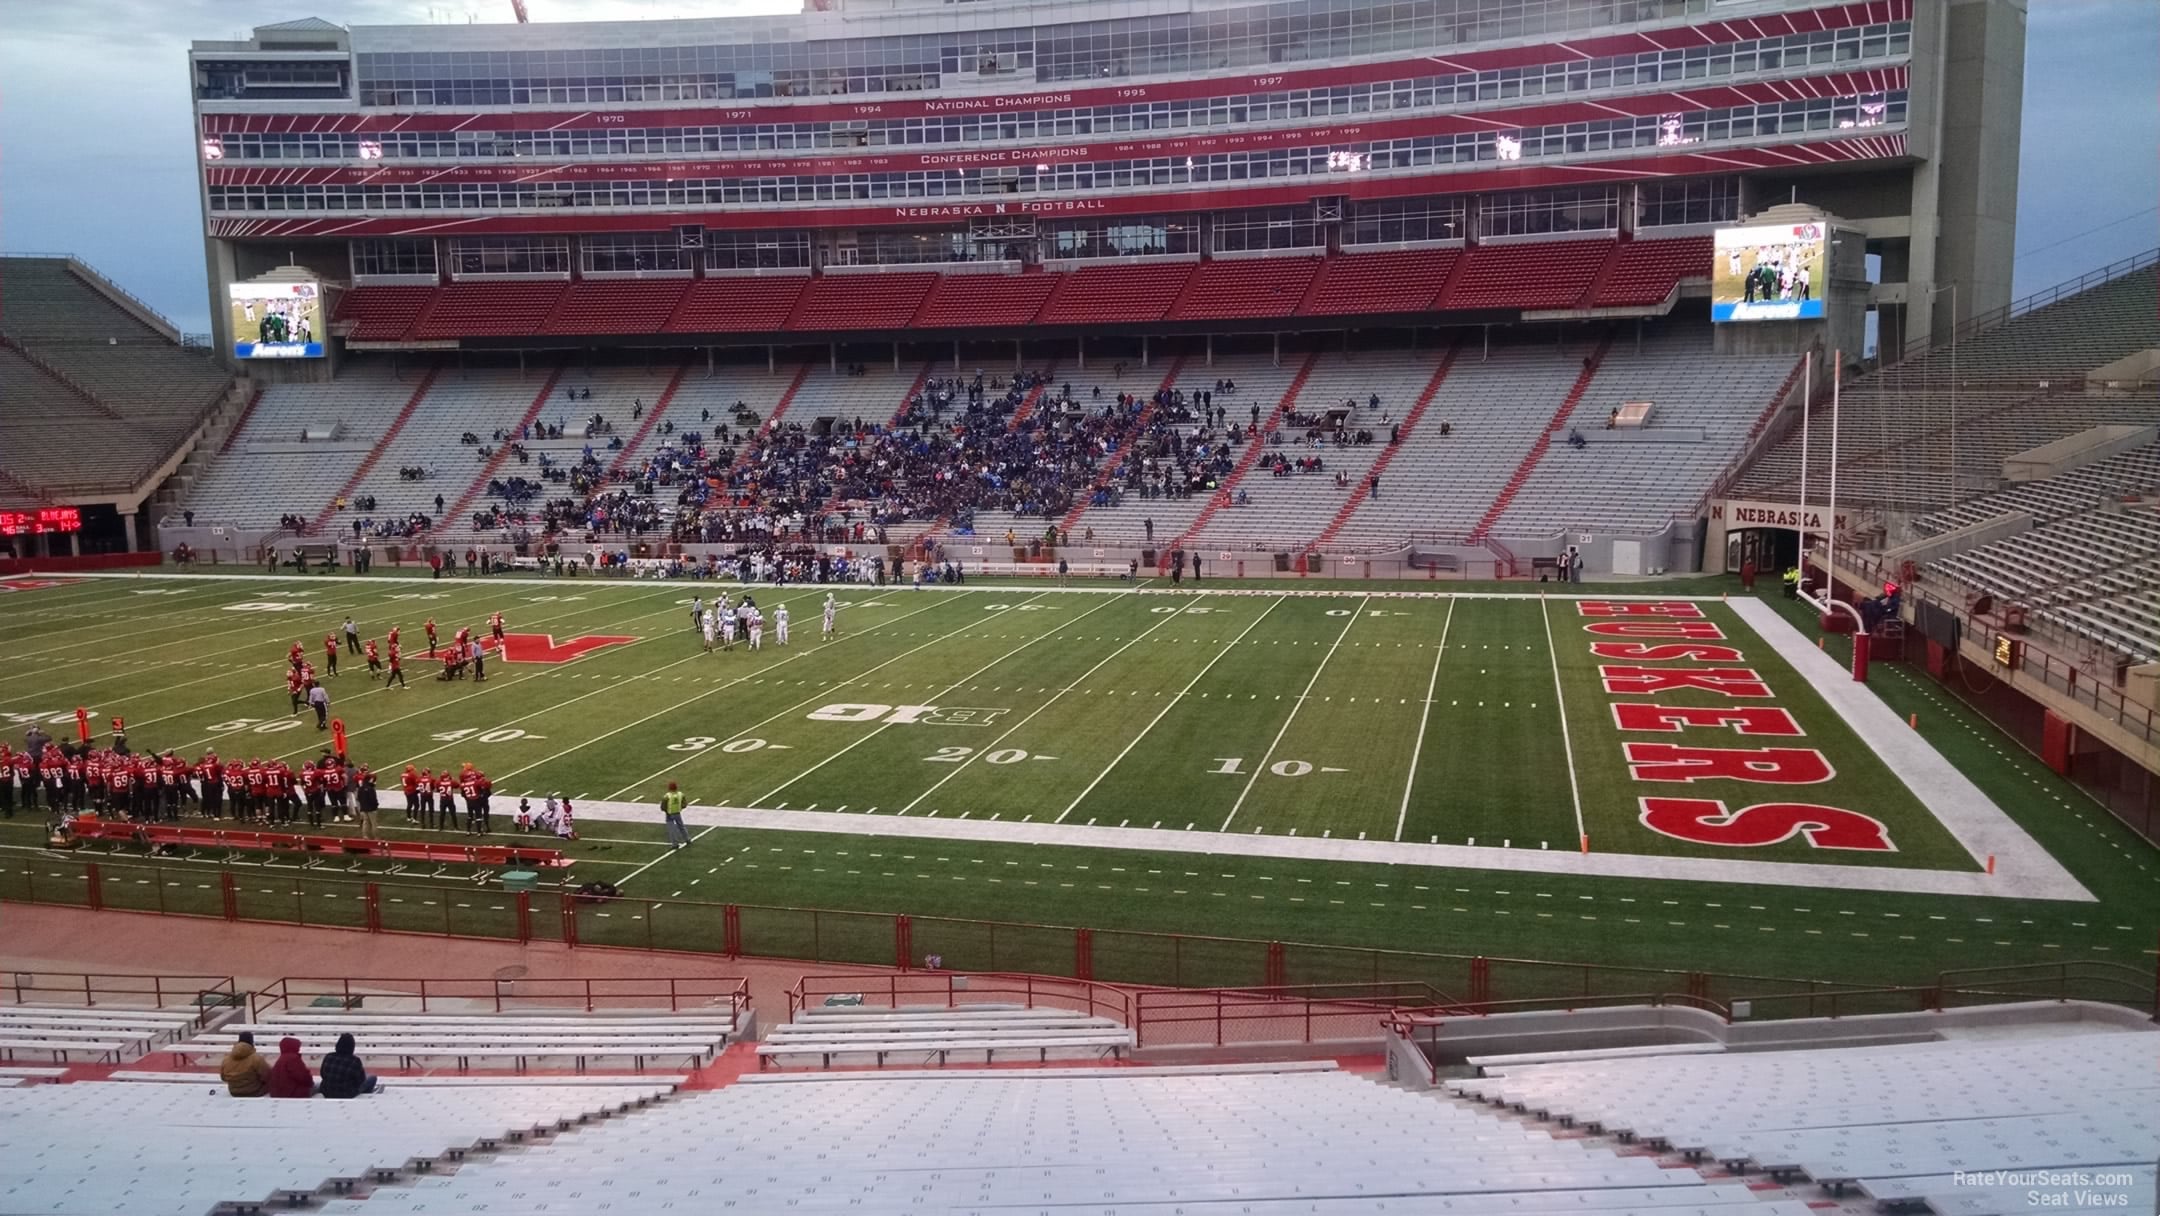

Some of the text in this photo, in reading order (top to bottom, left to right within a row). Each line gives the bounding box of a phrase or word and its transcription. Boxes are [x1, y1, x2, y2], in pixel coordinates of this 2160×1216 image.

[596, 115, 625, 123] 1970
[725, 111, 752, 120] 1971
[854, 105, 882, 114] 1994
[1116, 88, 1147, 97] 1995
[1252, 76, 1284, 86] 1997
[1712, 506, 1722, 519] N
[1736, 508, 1821, 528] NEBRASKA
[1576, 600, 1899, 852] HUSKERS
[666, 736, 767, 752] 30
[922, 746, 1028, 764] 20
[1206, 758, 1313, 777] 10
